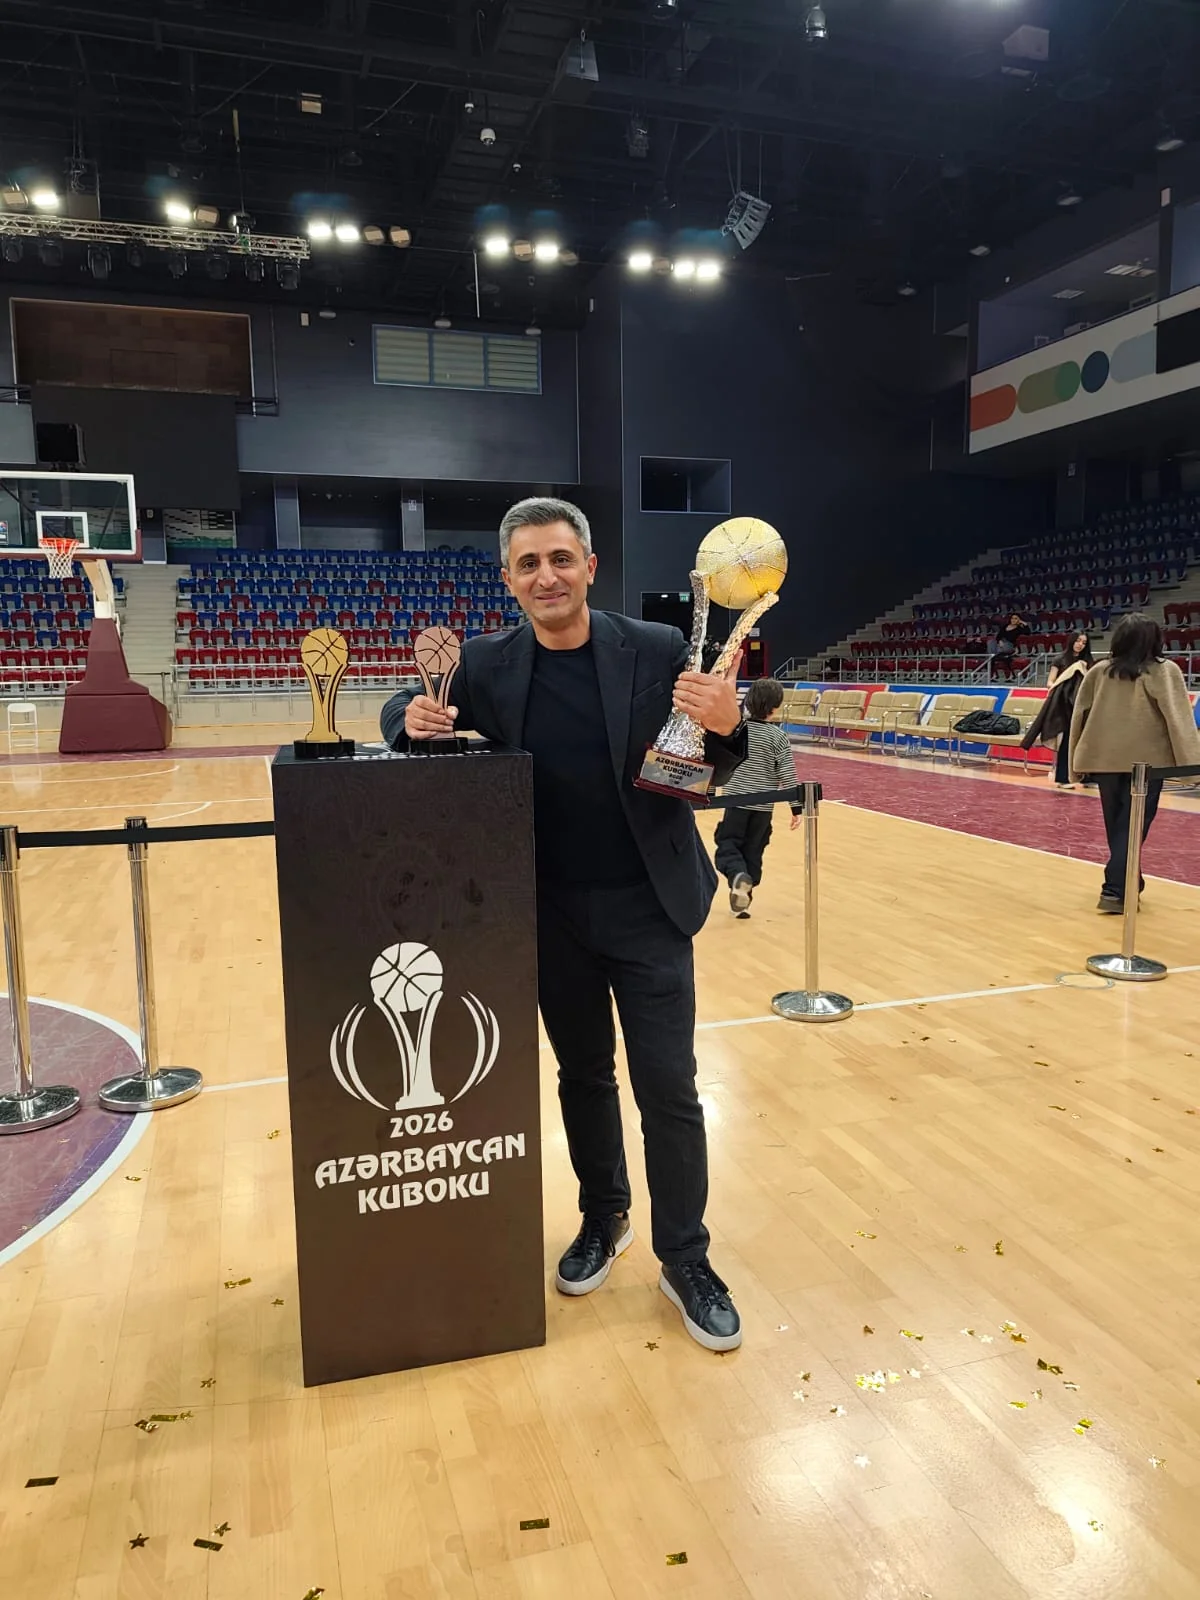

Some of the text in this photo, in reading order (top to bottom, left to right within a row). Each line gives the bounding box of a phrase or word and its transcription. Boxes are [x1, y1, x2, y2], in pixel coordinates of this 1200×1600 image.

[655, 756, 704, 774] AZƏRBAYCAN
[663, 765, 693, 777] KUBOKU
[389, 1110, 454, 1139] 2026
[314, 1132, 526, 1190] AZƏRBAYCAN
[357, 1170, 490, 1214] KUBOKU
